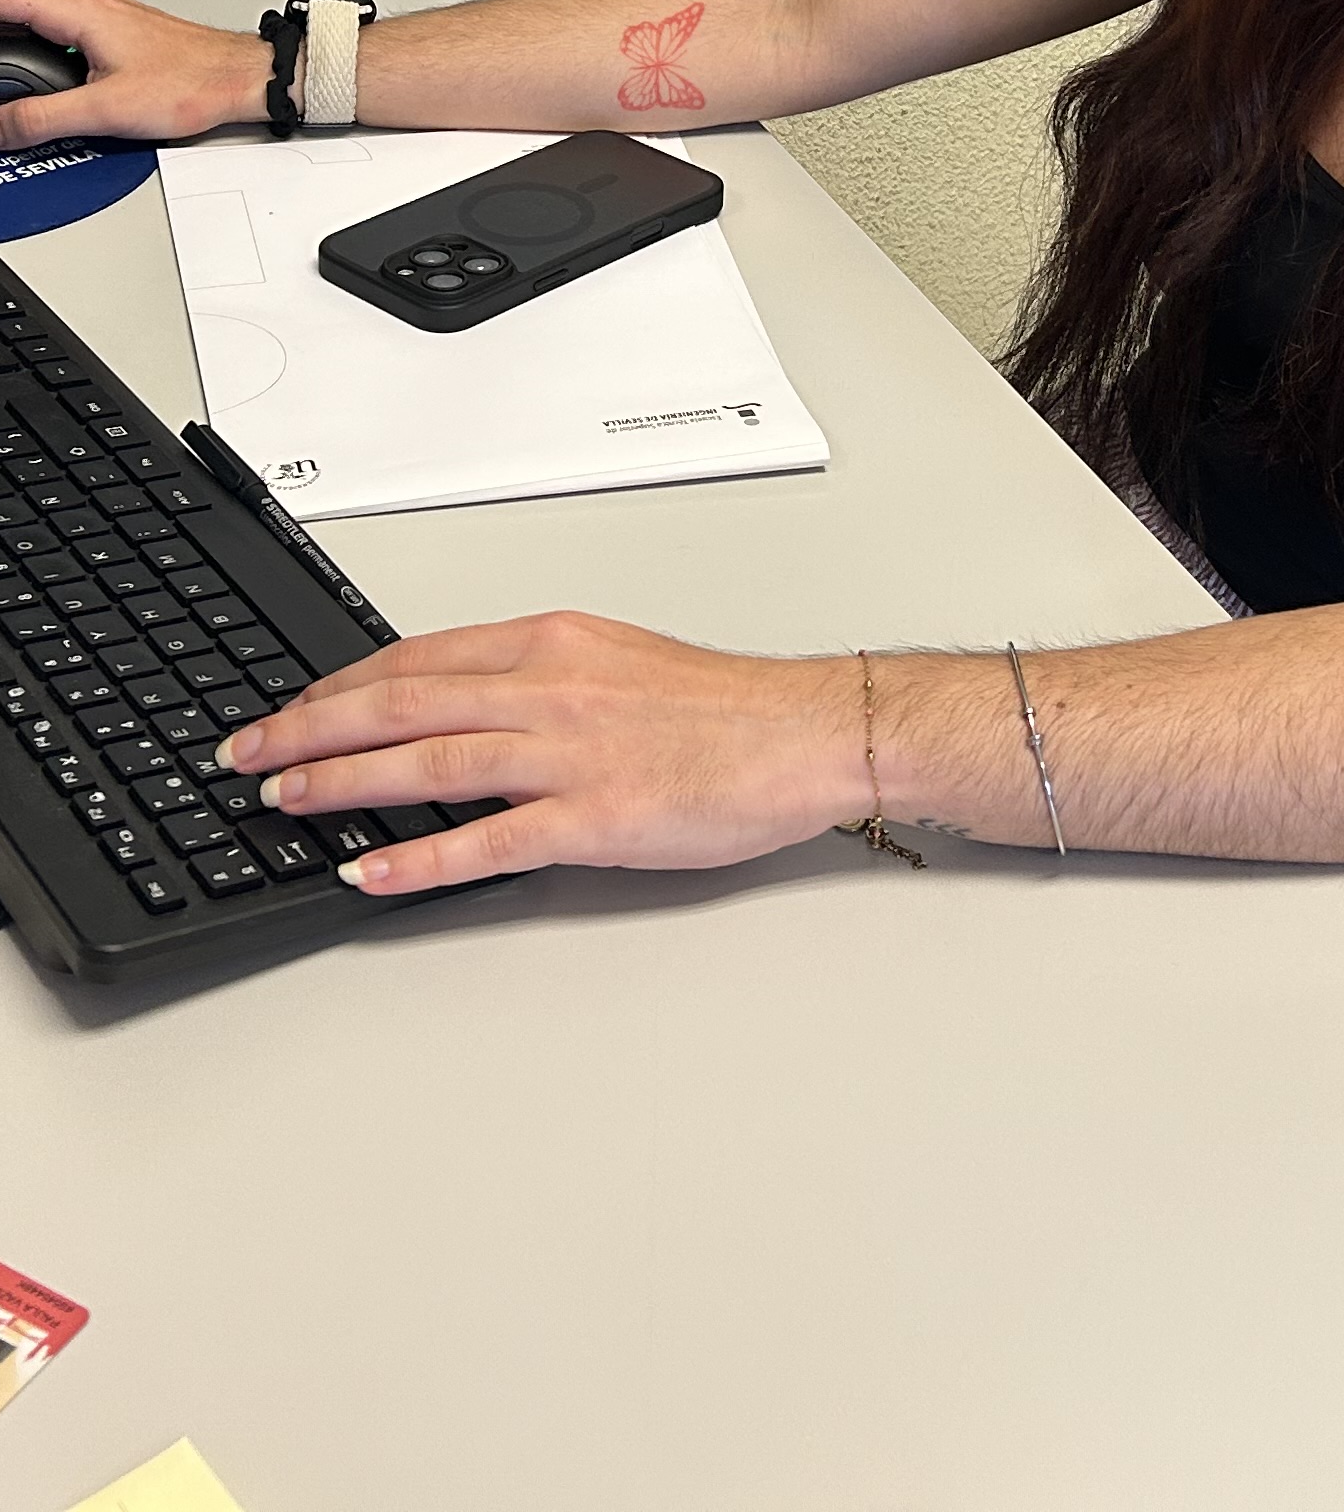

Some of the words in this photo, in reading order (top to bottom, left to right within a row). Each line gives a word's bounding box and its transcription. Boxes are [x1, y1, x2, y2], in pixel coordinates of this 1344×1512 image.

[60, 138, 86, 155] de
[13, 148, 103, 179] SEVILLA
[266, 501, 309, 546] STAEDTLER
[301, 542, 341, 583] permanent
